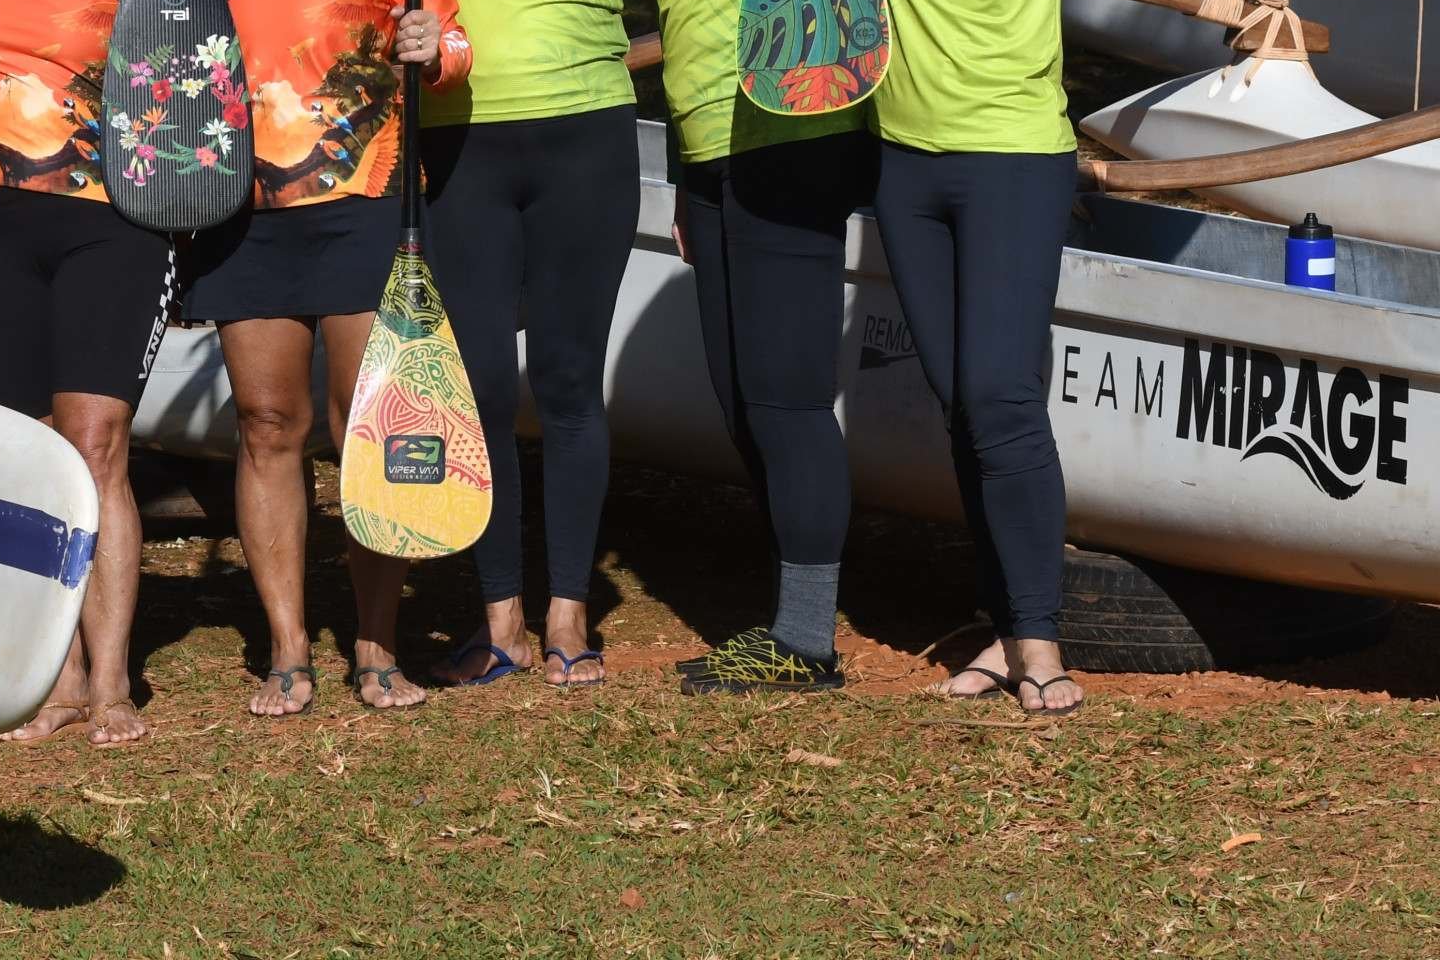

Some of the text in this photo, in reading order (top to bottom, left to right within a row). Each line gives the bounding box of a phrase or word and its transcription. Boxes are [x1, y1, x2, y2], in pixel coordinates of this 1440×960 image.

[138, 315, 169, 380] VANS
[863, 314, 913, 353] REMO
[1061, 336, 1410, 486] EAM MIRAGE
[388, 465, 417, 474] VIPER
